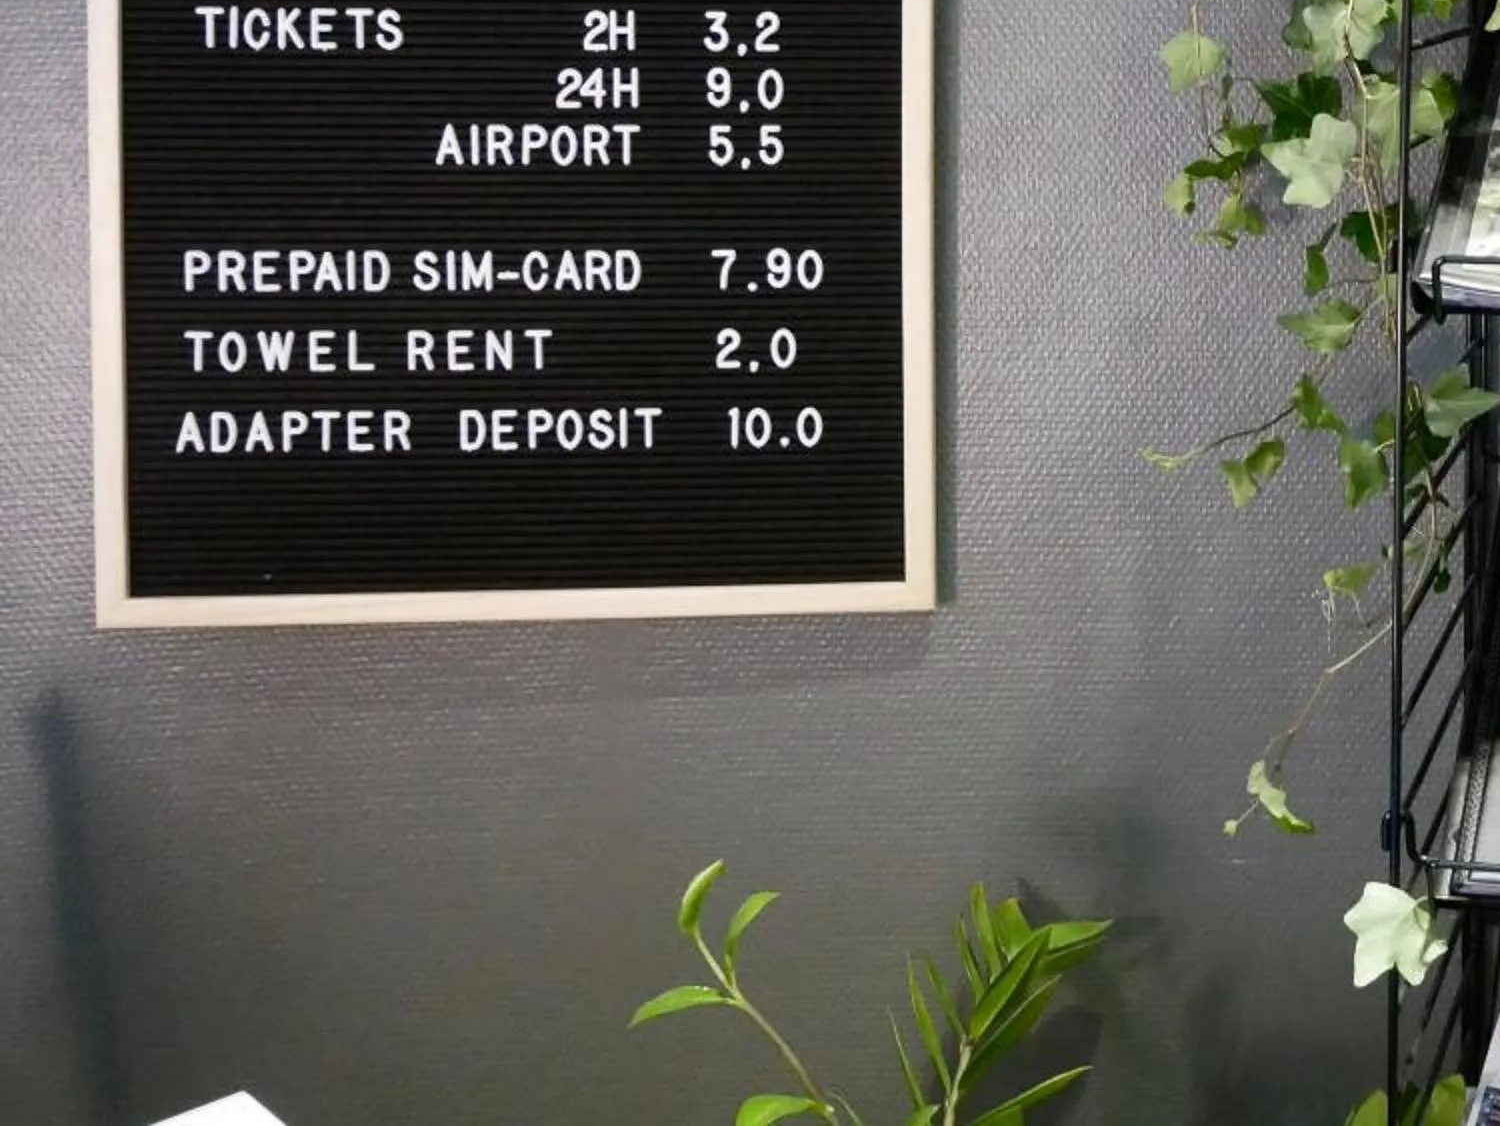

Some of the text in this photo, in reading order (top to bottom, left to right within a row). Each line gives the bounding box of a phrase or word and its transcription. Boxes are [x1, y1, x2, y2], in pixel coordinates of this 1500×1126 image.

[194, 5, 404, 52] TICKETS
[582, 9, 636, 53] 2H
[555, 67, 639, 109] 24H
[435, 123, 641, 167] AIRPORT
[183, 247, 824, 293] PREPAID SIM-CARD 7.90
[183, 329, 375, 373] TOWEL
[407, 329, 553, 372] RENT
[175, 406, 824, 454] ADAPTER DEPOSIT 10.0
